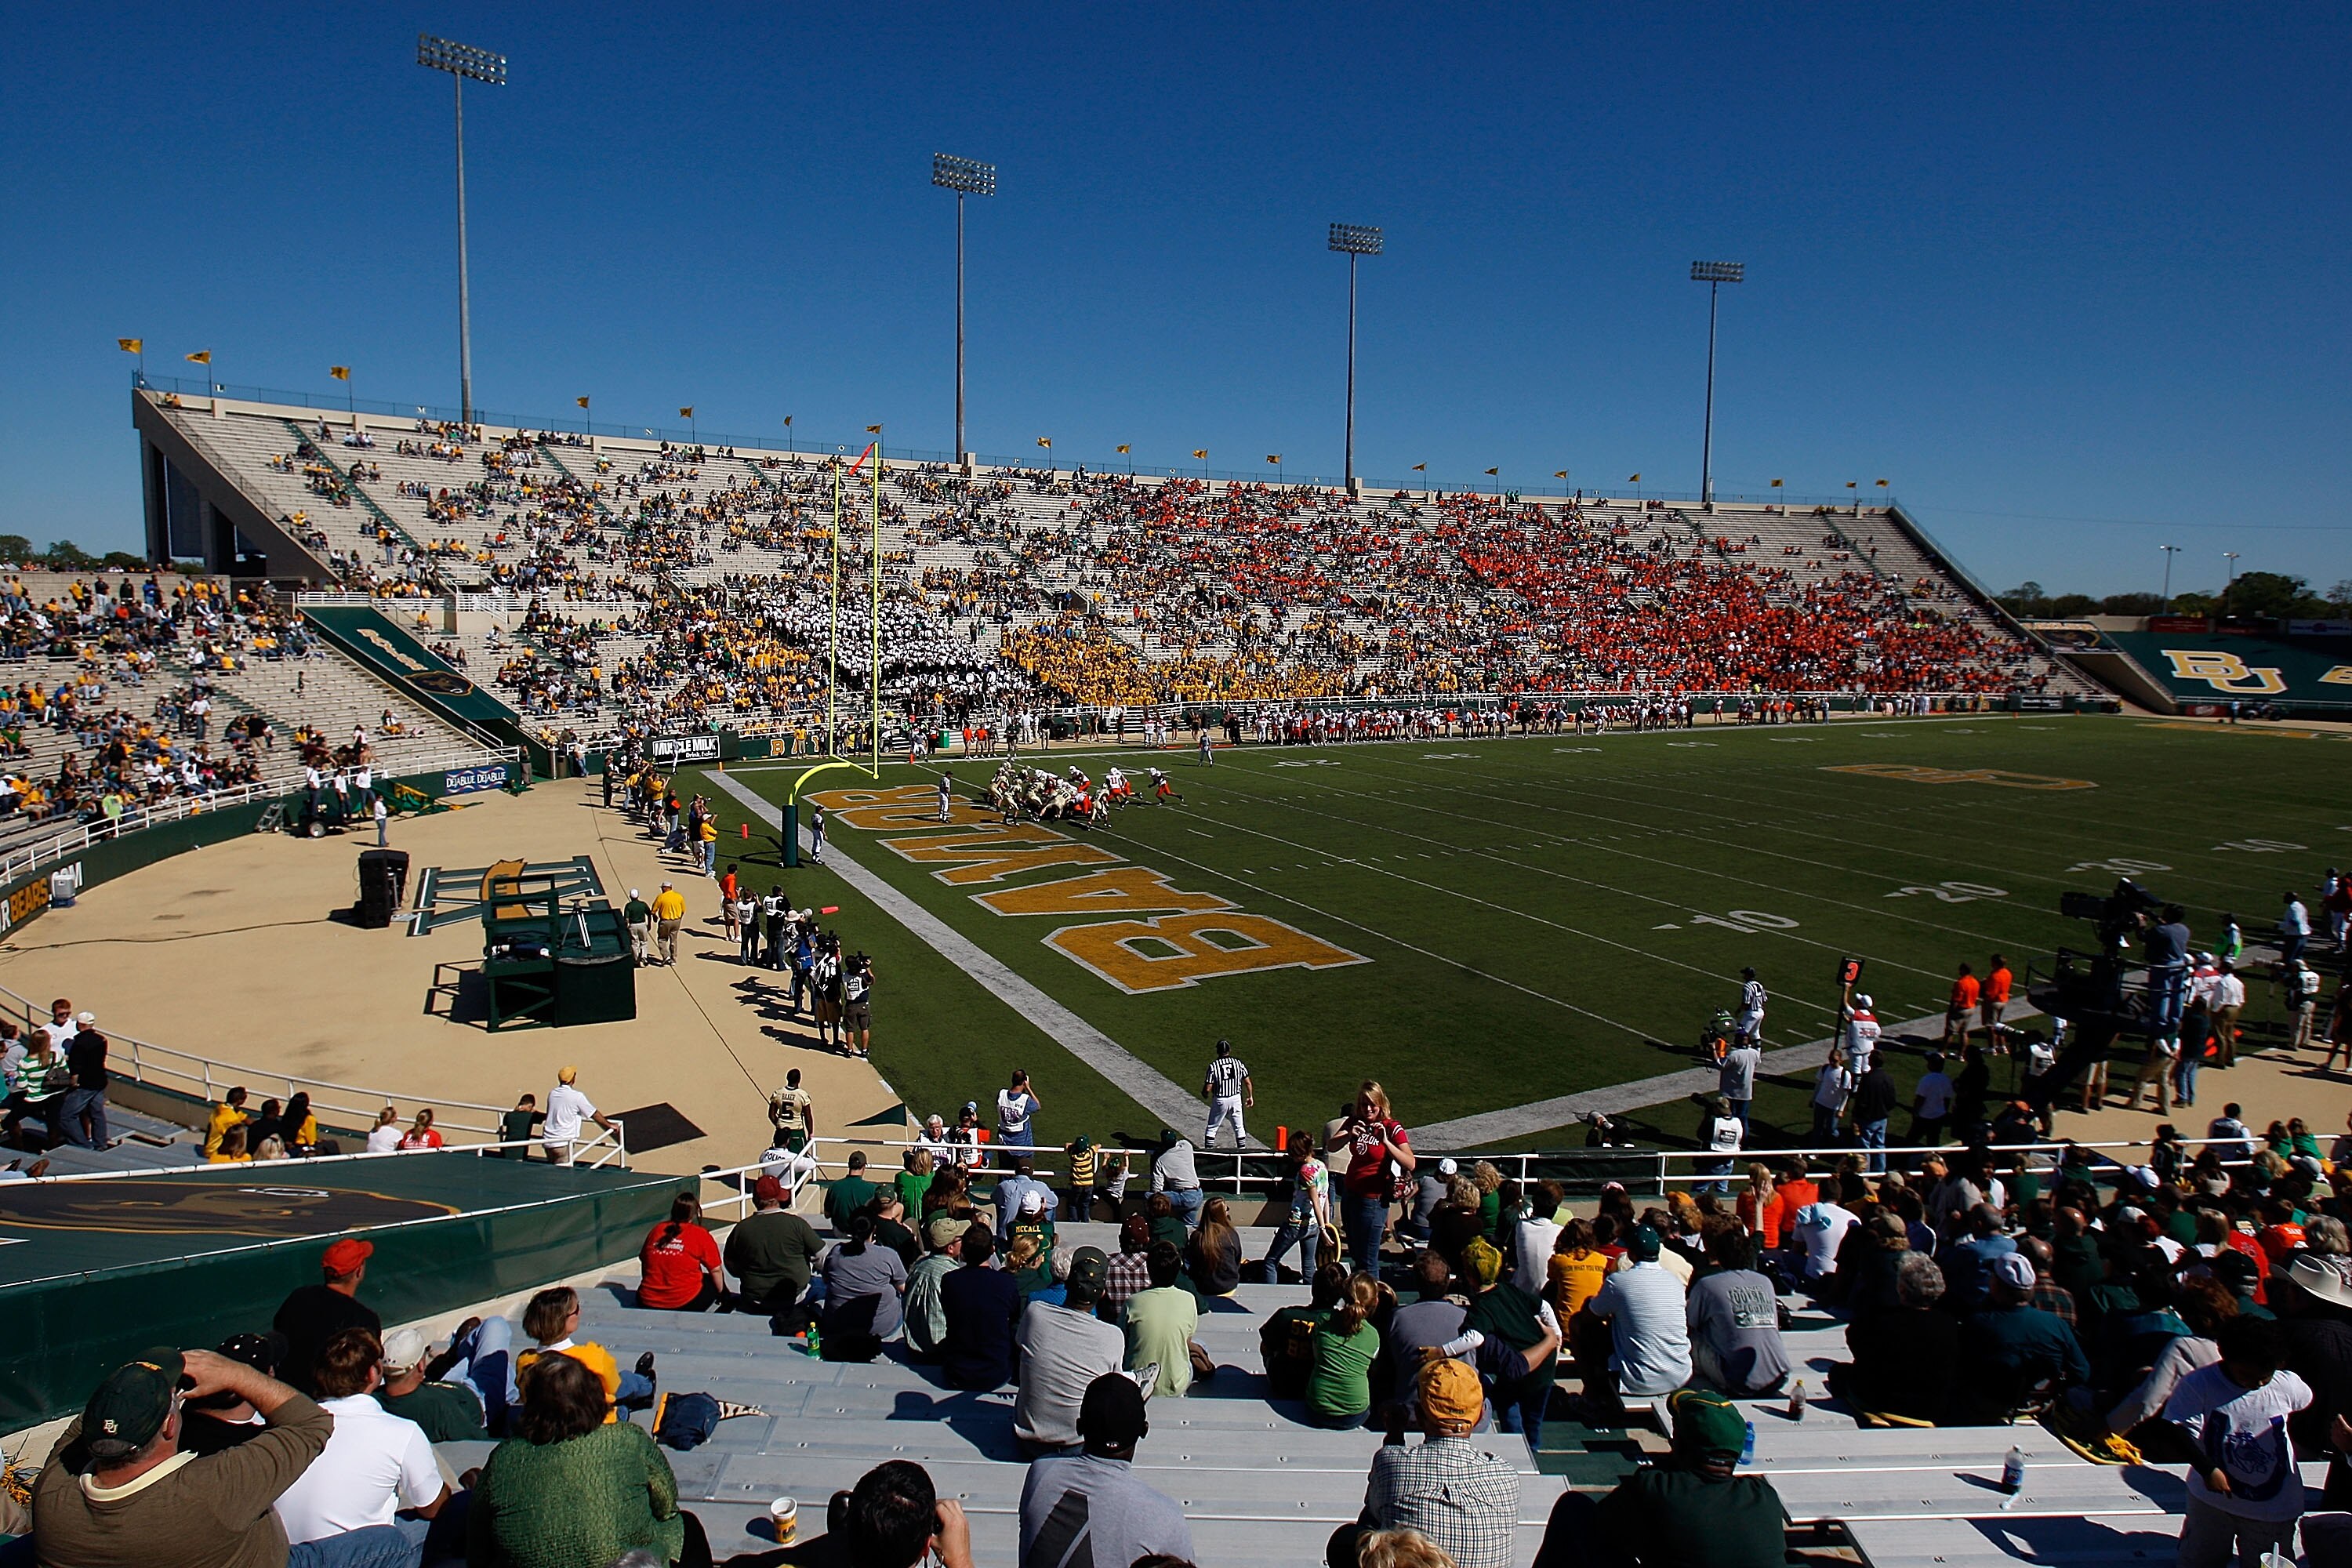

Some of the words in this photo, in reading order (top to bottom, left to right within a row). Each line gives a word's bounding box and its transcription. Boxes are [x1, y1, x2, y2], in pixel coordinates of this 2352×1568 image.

[2161, 650, 2288, 694] BU
[692, 739, 717, 751] MILK
[2074, 858, 2173, 877] 30
[1900, 882, 2009, 903] 20
[1690, 909, 1800, 934] 10
[1844, 961, 1859, 981] 3
[1221, 1063, 1232, 1080] F
[780, 1100, 794, 1120] 5
[1015, 1225, 1042, 1233] MCCALL
[103, 1419, 119, 1434] BU
